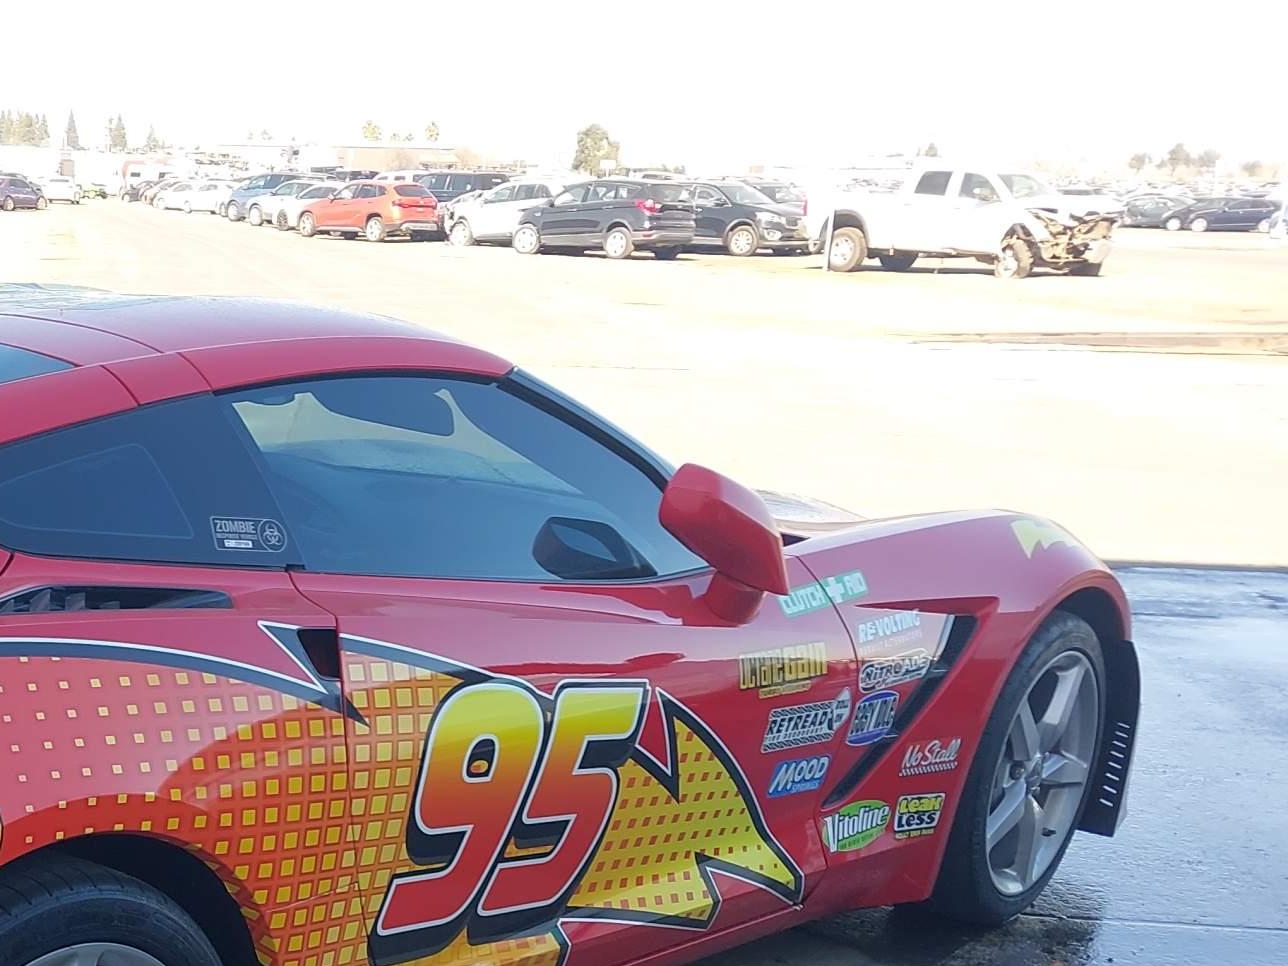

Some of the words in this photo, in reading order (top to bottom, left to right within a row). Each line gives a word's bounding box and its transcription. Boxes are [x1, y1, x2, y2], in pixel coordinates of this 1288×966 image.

[214, 519, 257, 534] ZOMBIE
[767, 710, 828, 736] RETREAD
[901, 744, 923, 768] No
[921, 738, 961, 765] Stall
[768, 756, 830, 794] MOOD
[370, 680, 650, 960] 95
[823, 805, 890, 853] Vitoline
